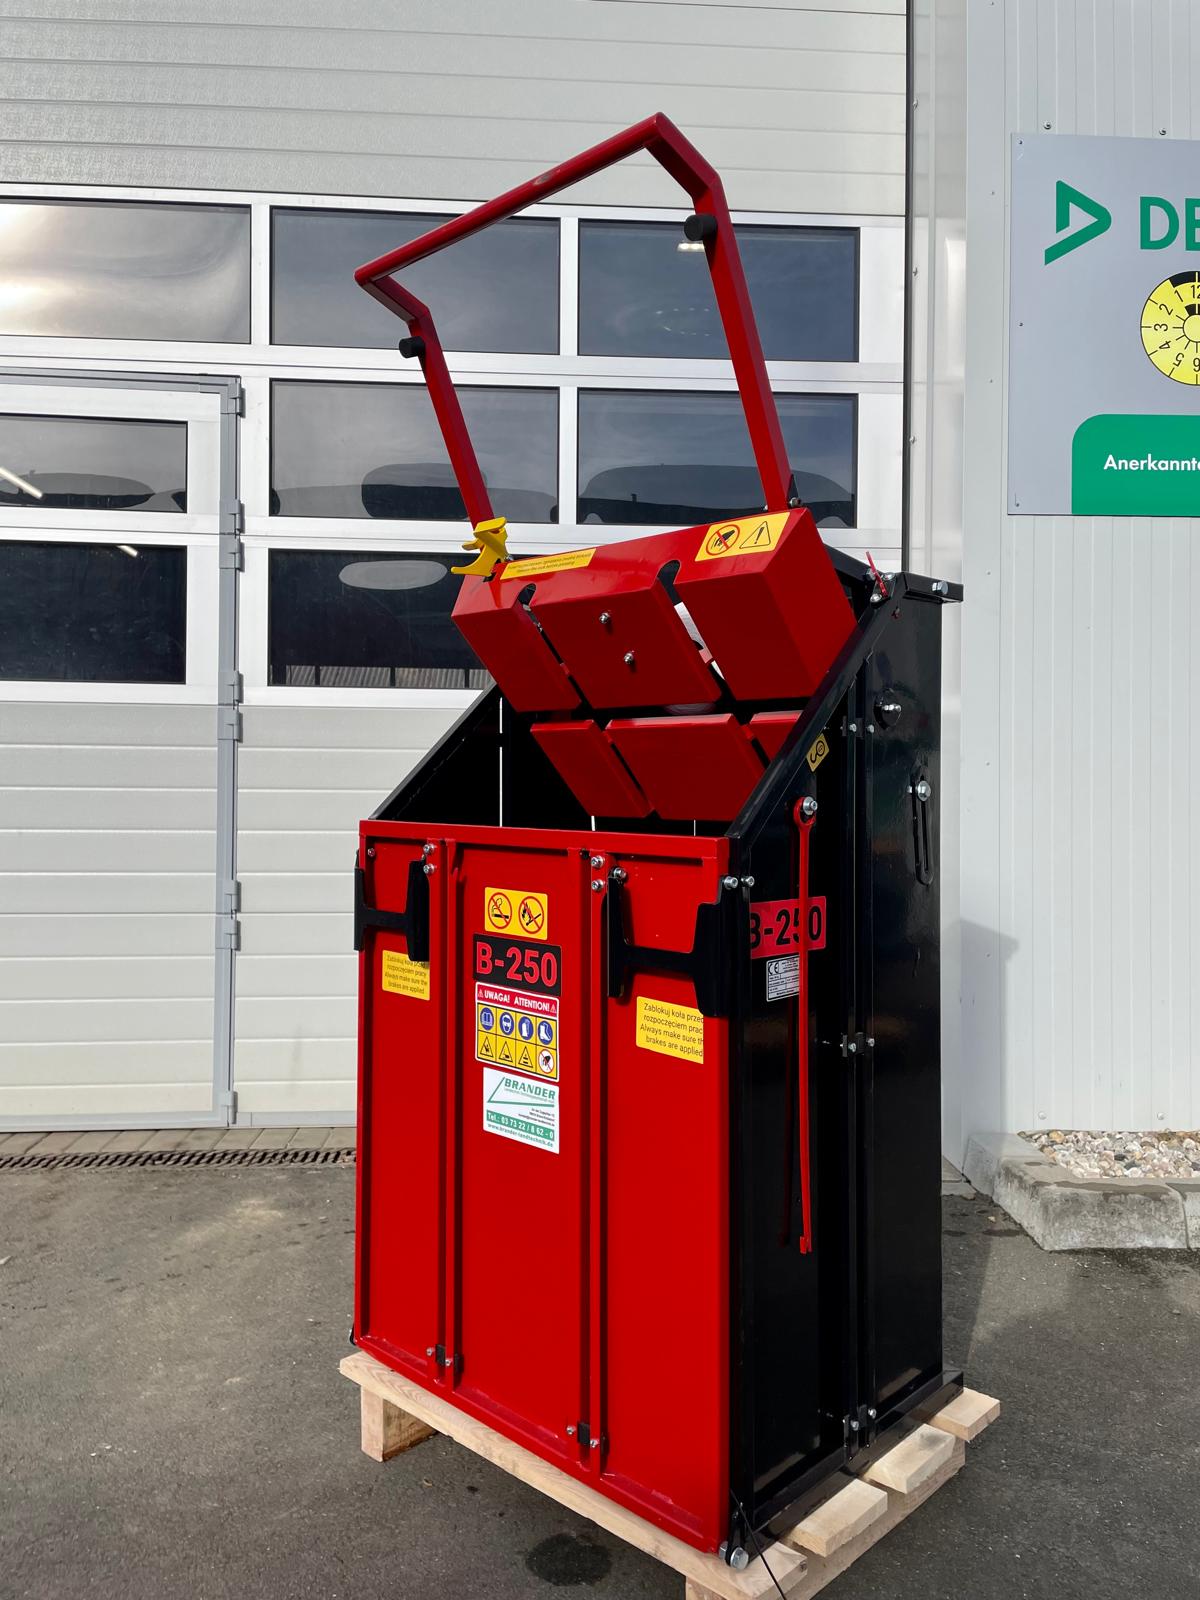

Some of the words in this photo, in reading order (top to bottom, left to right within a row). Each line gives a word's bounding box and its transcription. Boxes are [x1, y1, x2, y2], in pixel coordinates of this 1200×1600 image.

[1174, 290, 1183, 302] 1
[1159, 303, 1173, 315] 2
[1153, 323, 1169, 332] 3
[1158, 340, 1172, 350] 4
[1172, 352, 1185, 367] 5
[1103, 453, 1200, 471] Anerkannt
[476, 941, 558, 987] B-250
[484, 989, 510, 1003] UWAGA!
[514, 995, 550, 1011] ATTENTION!
[644, 1002, 671, 1018] Zablokuj
[640, 1023, 662, 1035] Always
[663, 1029, 681, 1040] make
[682, 1035, 697, 1044] sure
[645, 1035, 667, 1047] brakes
[667, 1041, 679, 1050] are
[504, 1078, 556, 1100] BRANDER
